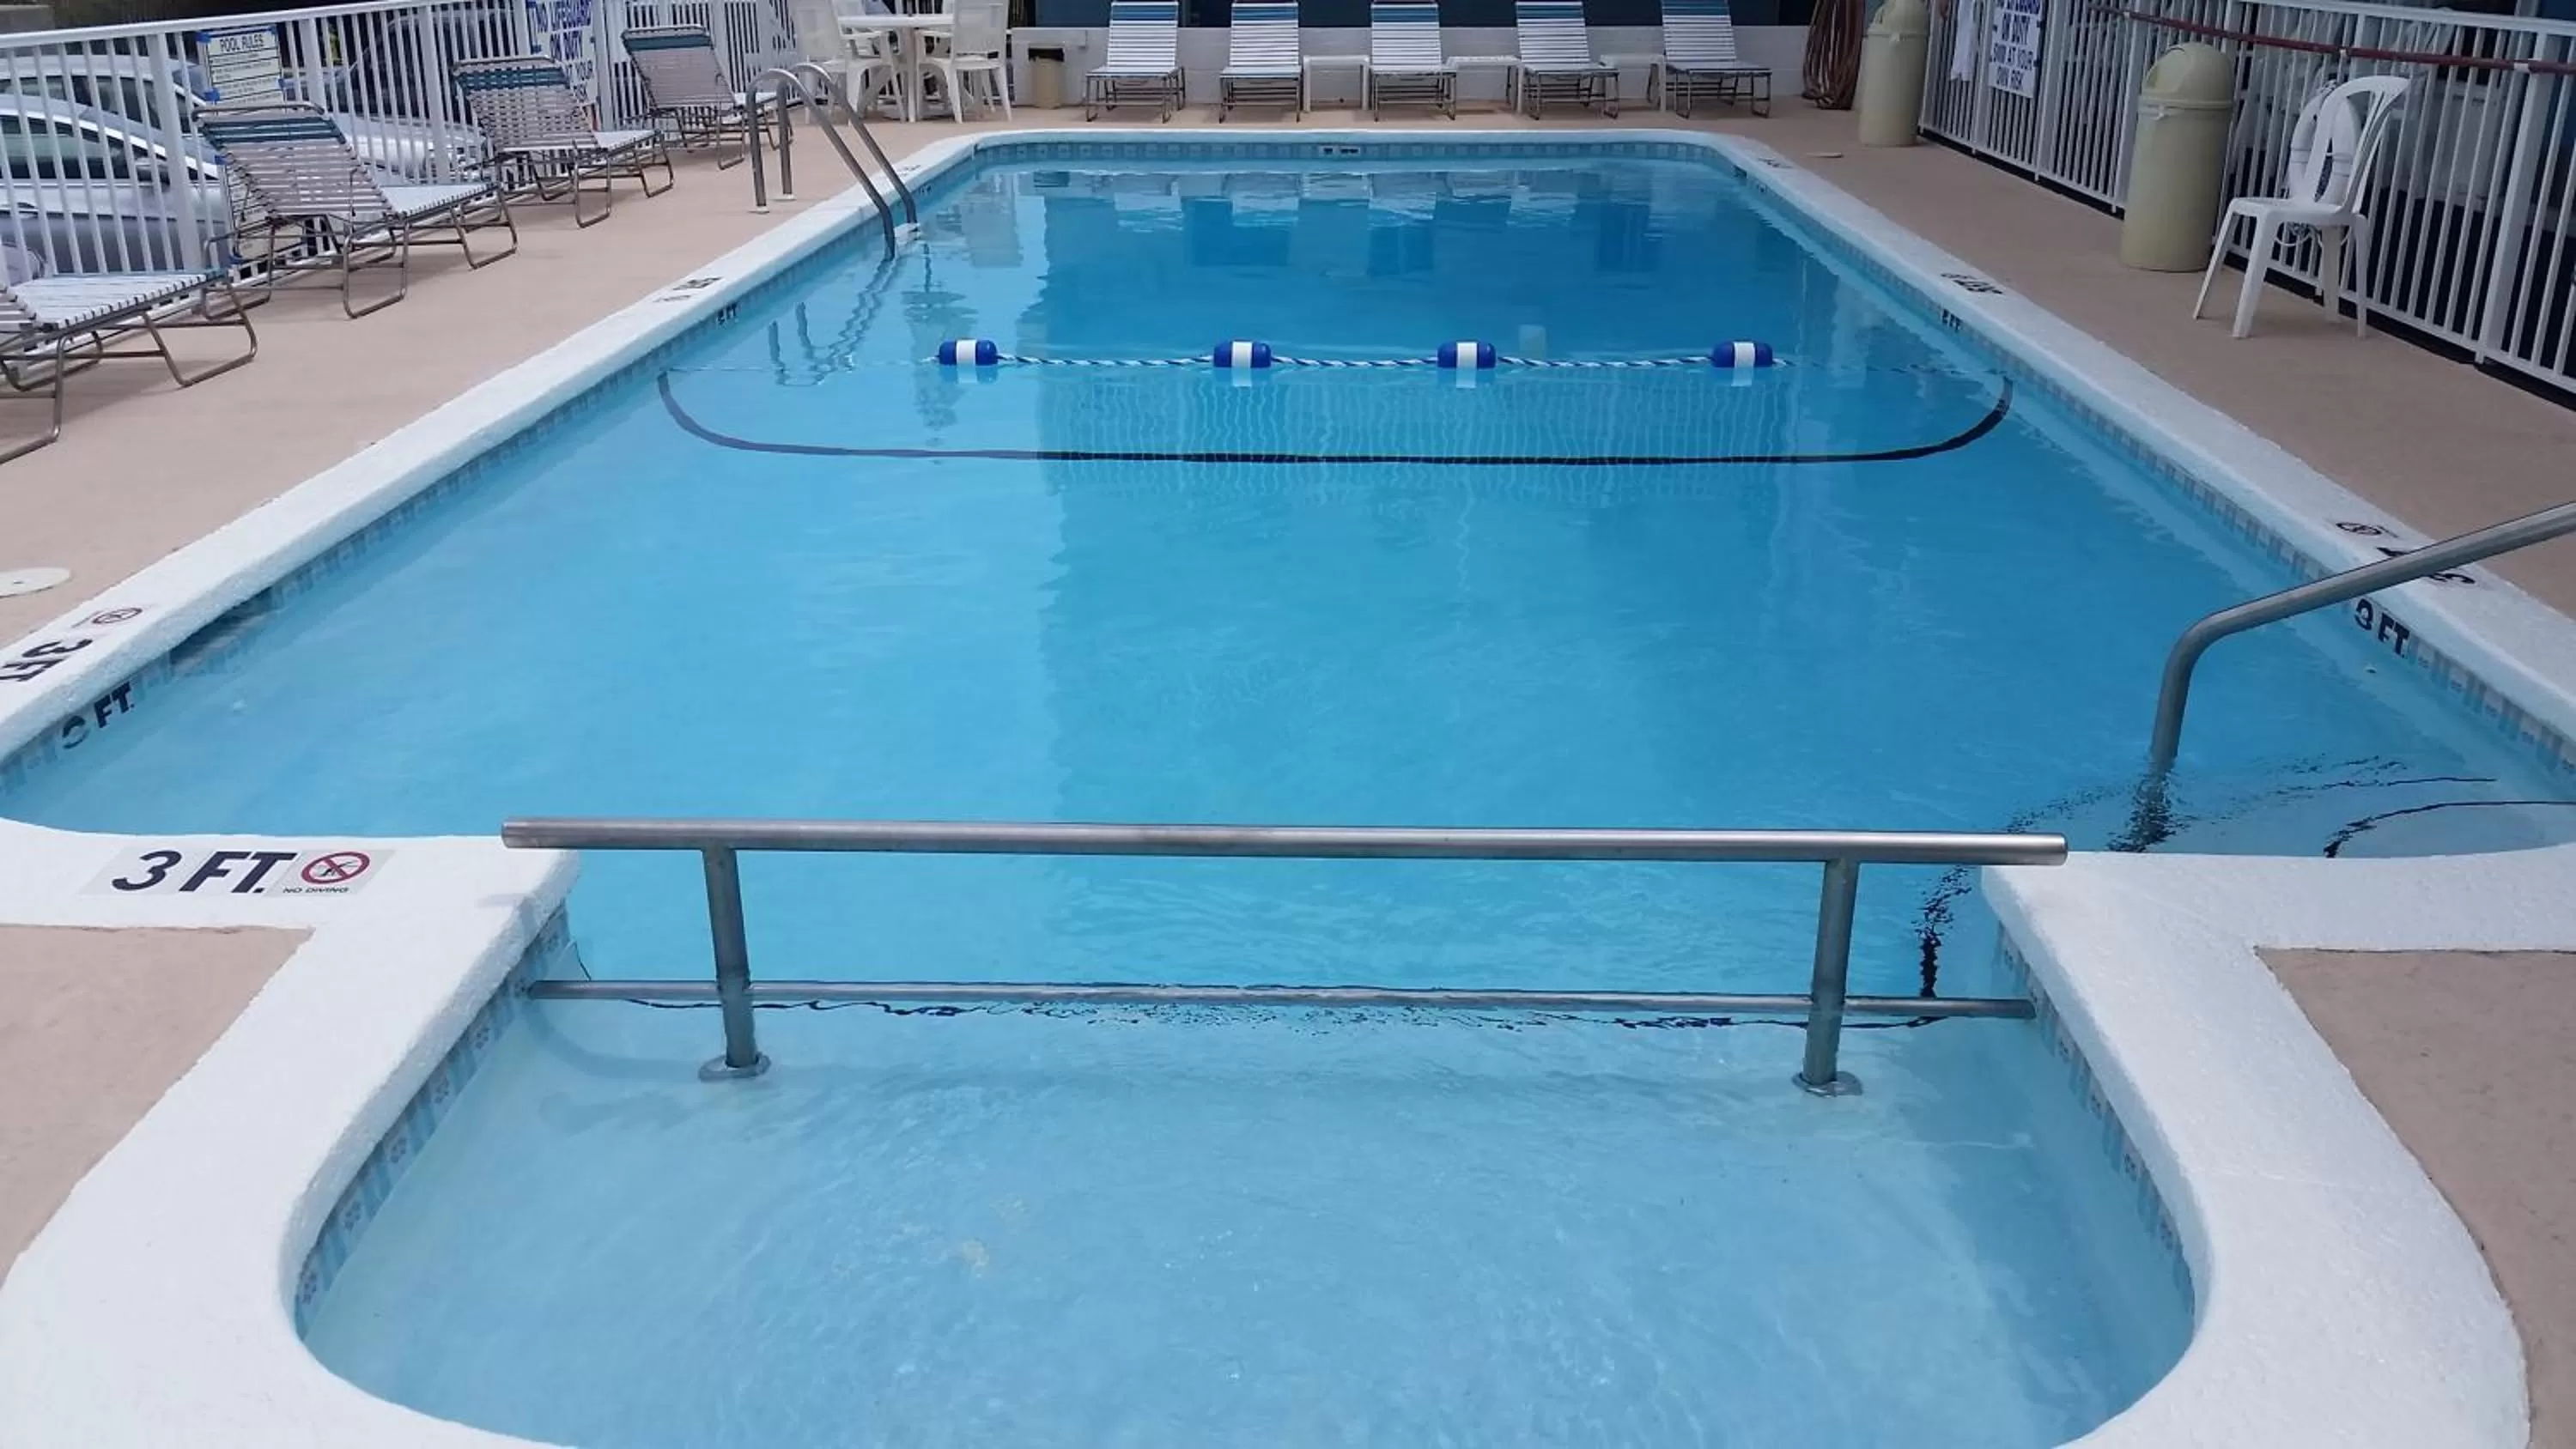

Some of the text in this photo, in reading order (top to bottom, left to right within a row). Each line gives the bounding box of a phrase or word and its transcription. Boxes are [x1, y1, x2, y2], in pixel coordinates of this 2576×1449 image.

[219, 33, 264, 52] POOL RULES
[2012, 14, 2030, 45] DUTY
[563, 30, 583, 60] DUTY
[2008, 45, 2017, 66] AT
[111, 849, 299, 894] 3 FT.
